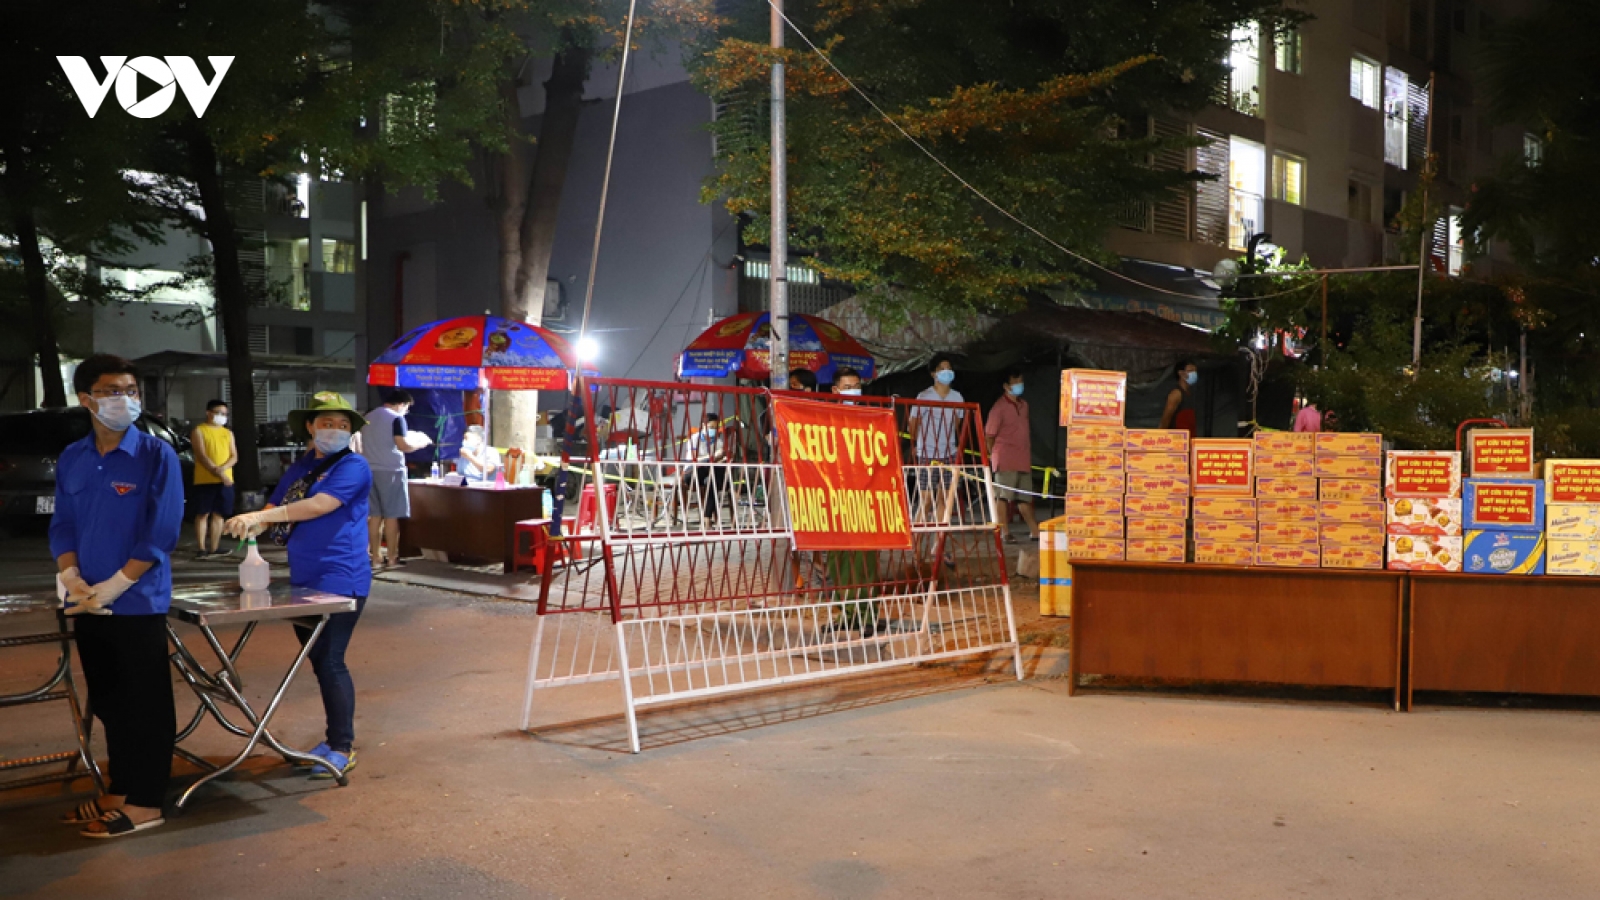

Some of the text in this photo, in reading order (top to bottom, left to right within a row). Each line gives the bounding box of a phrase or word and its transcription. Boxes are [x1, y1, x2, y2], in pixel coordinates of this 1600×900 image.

[787, 421, 888, 476] KHU VỰC
[787, 477, 907, 534] ĐANG PHONG TOẢ
